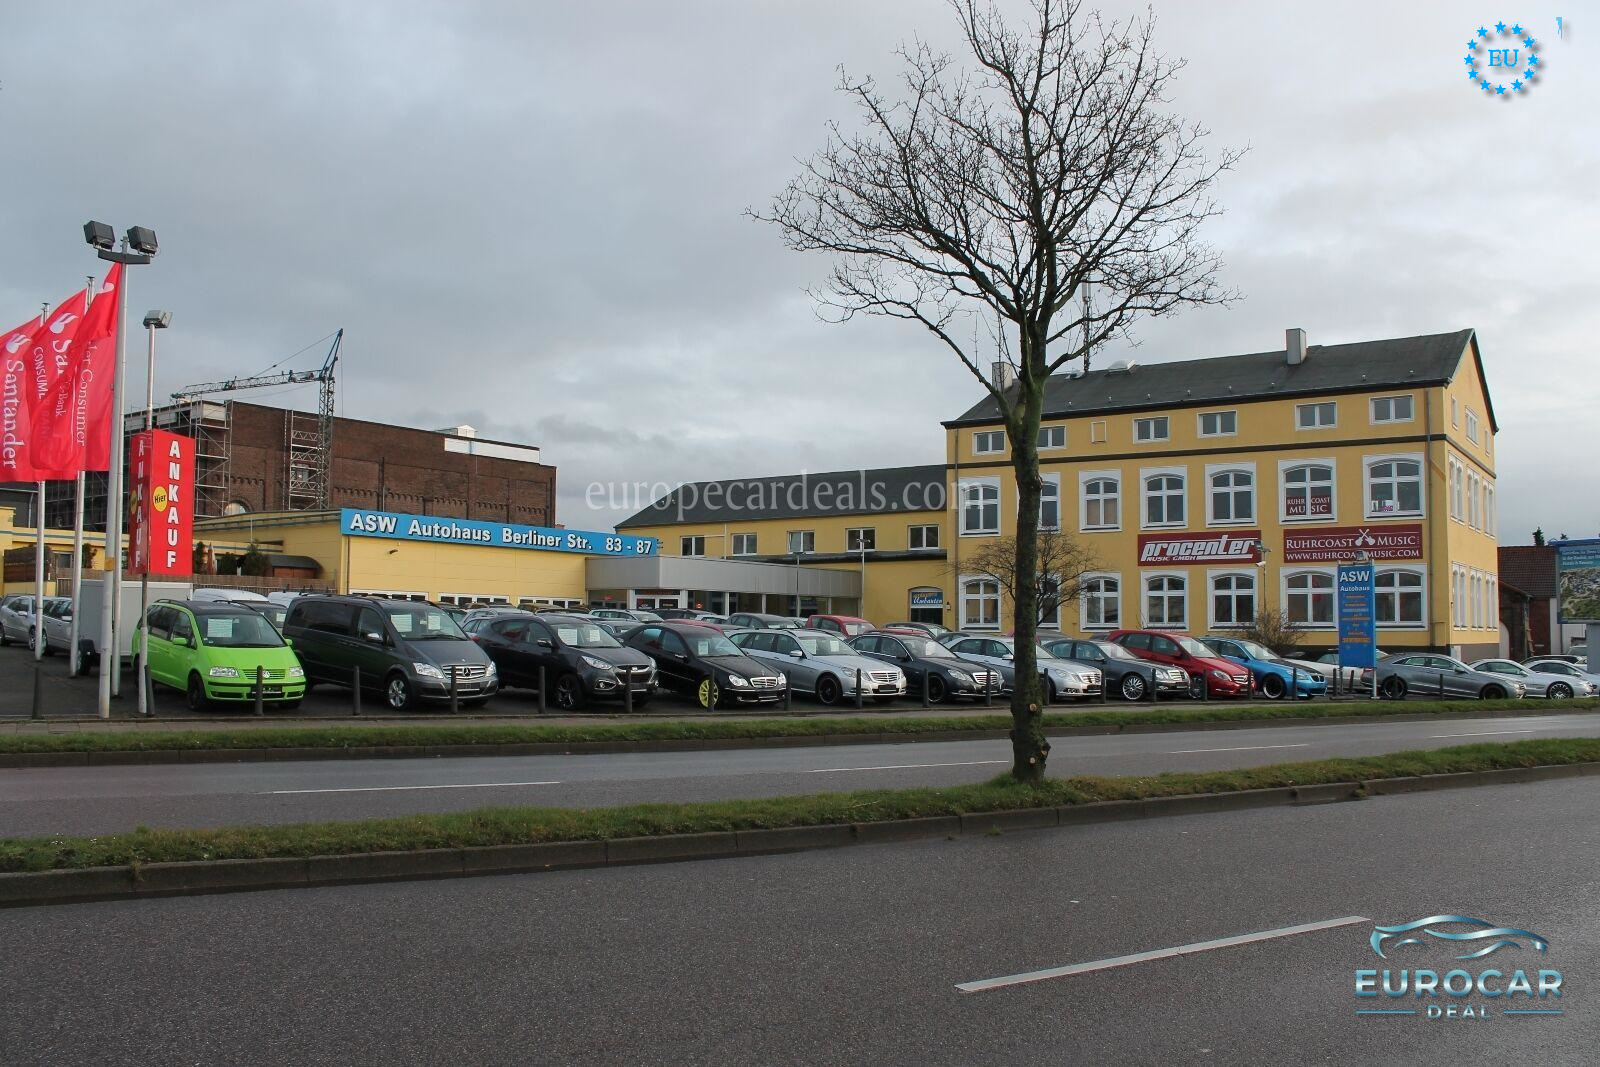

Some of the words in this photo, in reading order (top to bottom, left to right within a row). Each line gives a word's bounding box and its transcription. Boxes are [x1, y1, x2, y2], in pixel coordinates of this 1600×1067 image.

[3, 360, 25, 469] Santander
[76, 369, 94, 447] Consumer
[135, 440, 144, 568] ANKAUF
[154, 493, 167, 504] Hier
[167, 440, 181, 568] ANKAUF
[350, 513, 397, 533] ASW
[408, 519, 491, 541] Autohaus
[502, 527, 562, 547] Berliner
[567, 534, 592, 549] Str.
[606, 537, 622, 552] 83
[636, 540, 652, 554] 87
[1141, 535, 1254, 561] procenter
[1286, 538, 1354, 549] RUHRCOAST
[1377, 536, 1416, 546] MUSIC
[1286, 549, 1420, 560] WWW.RUHRCOAMUSIC.COM
[1340, 570, 1370, 582] ASW
